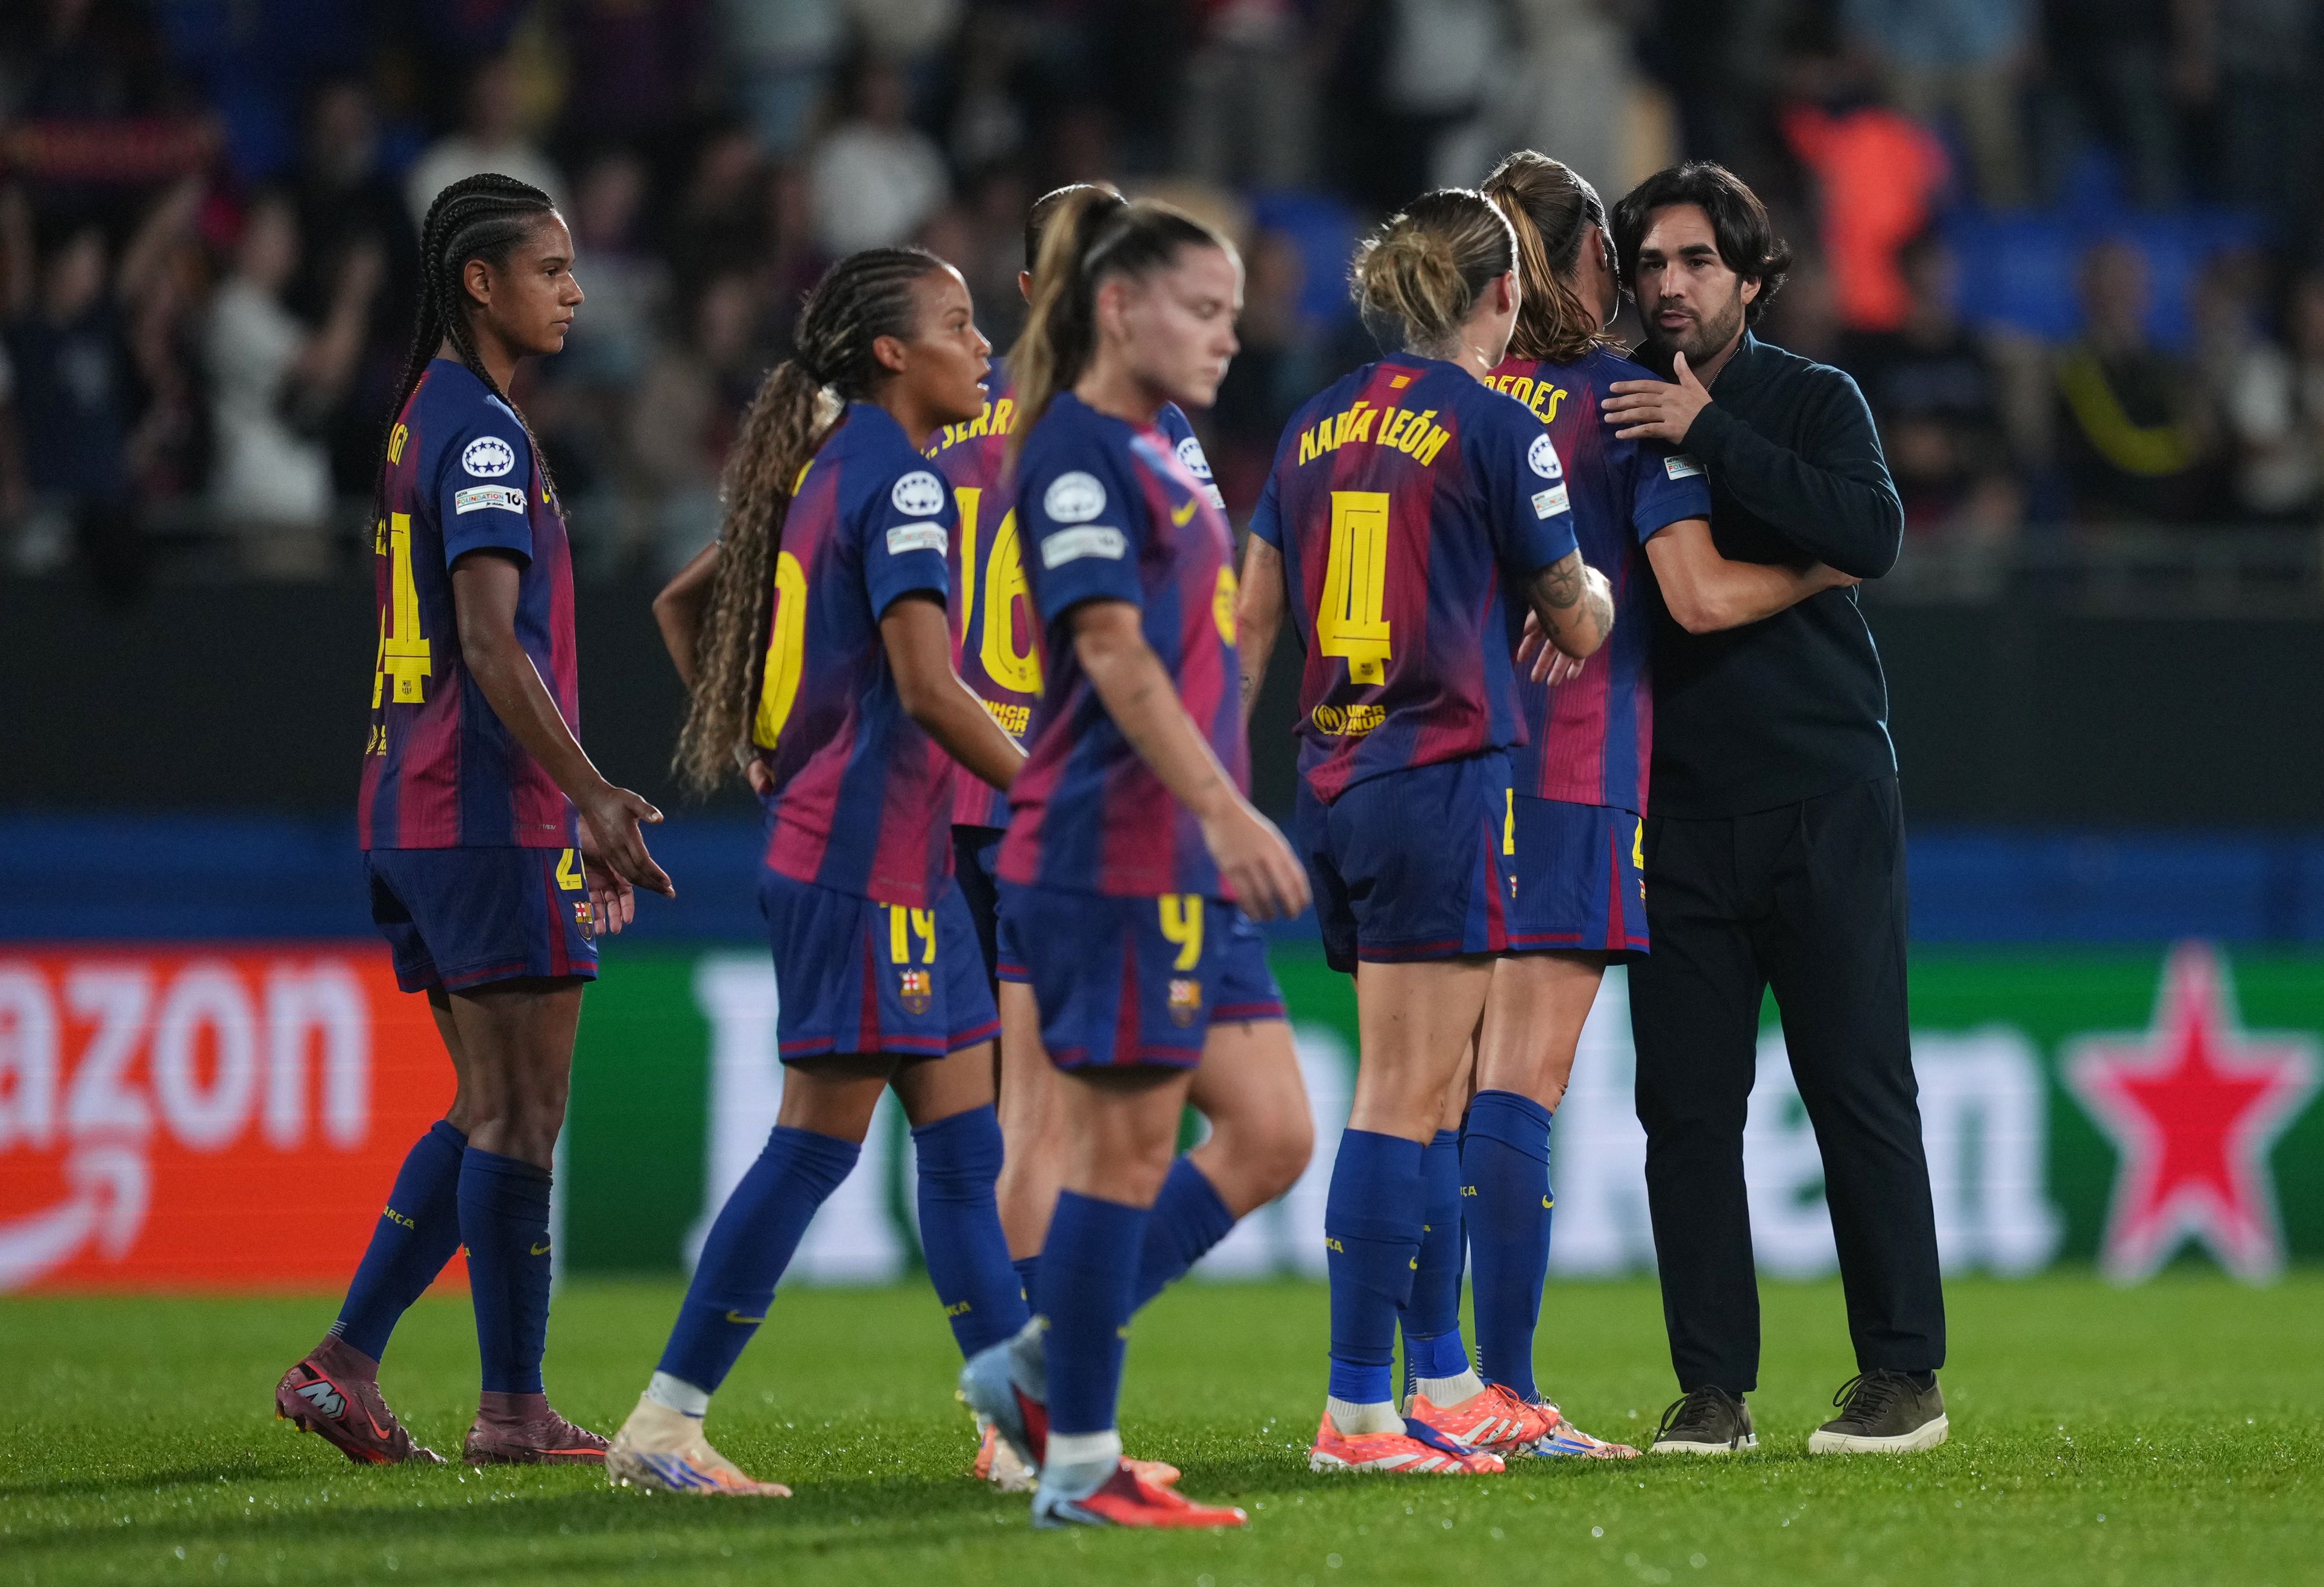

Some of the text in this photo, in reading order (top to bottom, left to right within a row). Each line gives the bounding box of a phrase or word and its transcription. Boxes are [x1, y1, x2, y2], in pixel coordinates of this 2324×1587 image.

[1375, 406, 1450, 467] LEÓN
[456, 492, 504, 506] FOUNDATION
[1316, 491, 1392, 686] 4
[1158, 892, 1204, 972] 9
